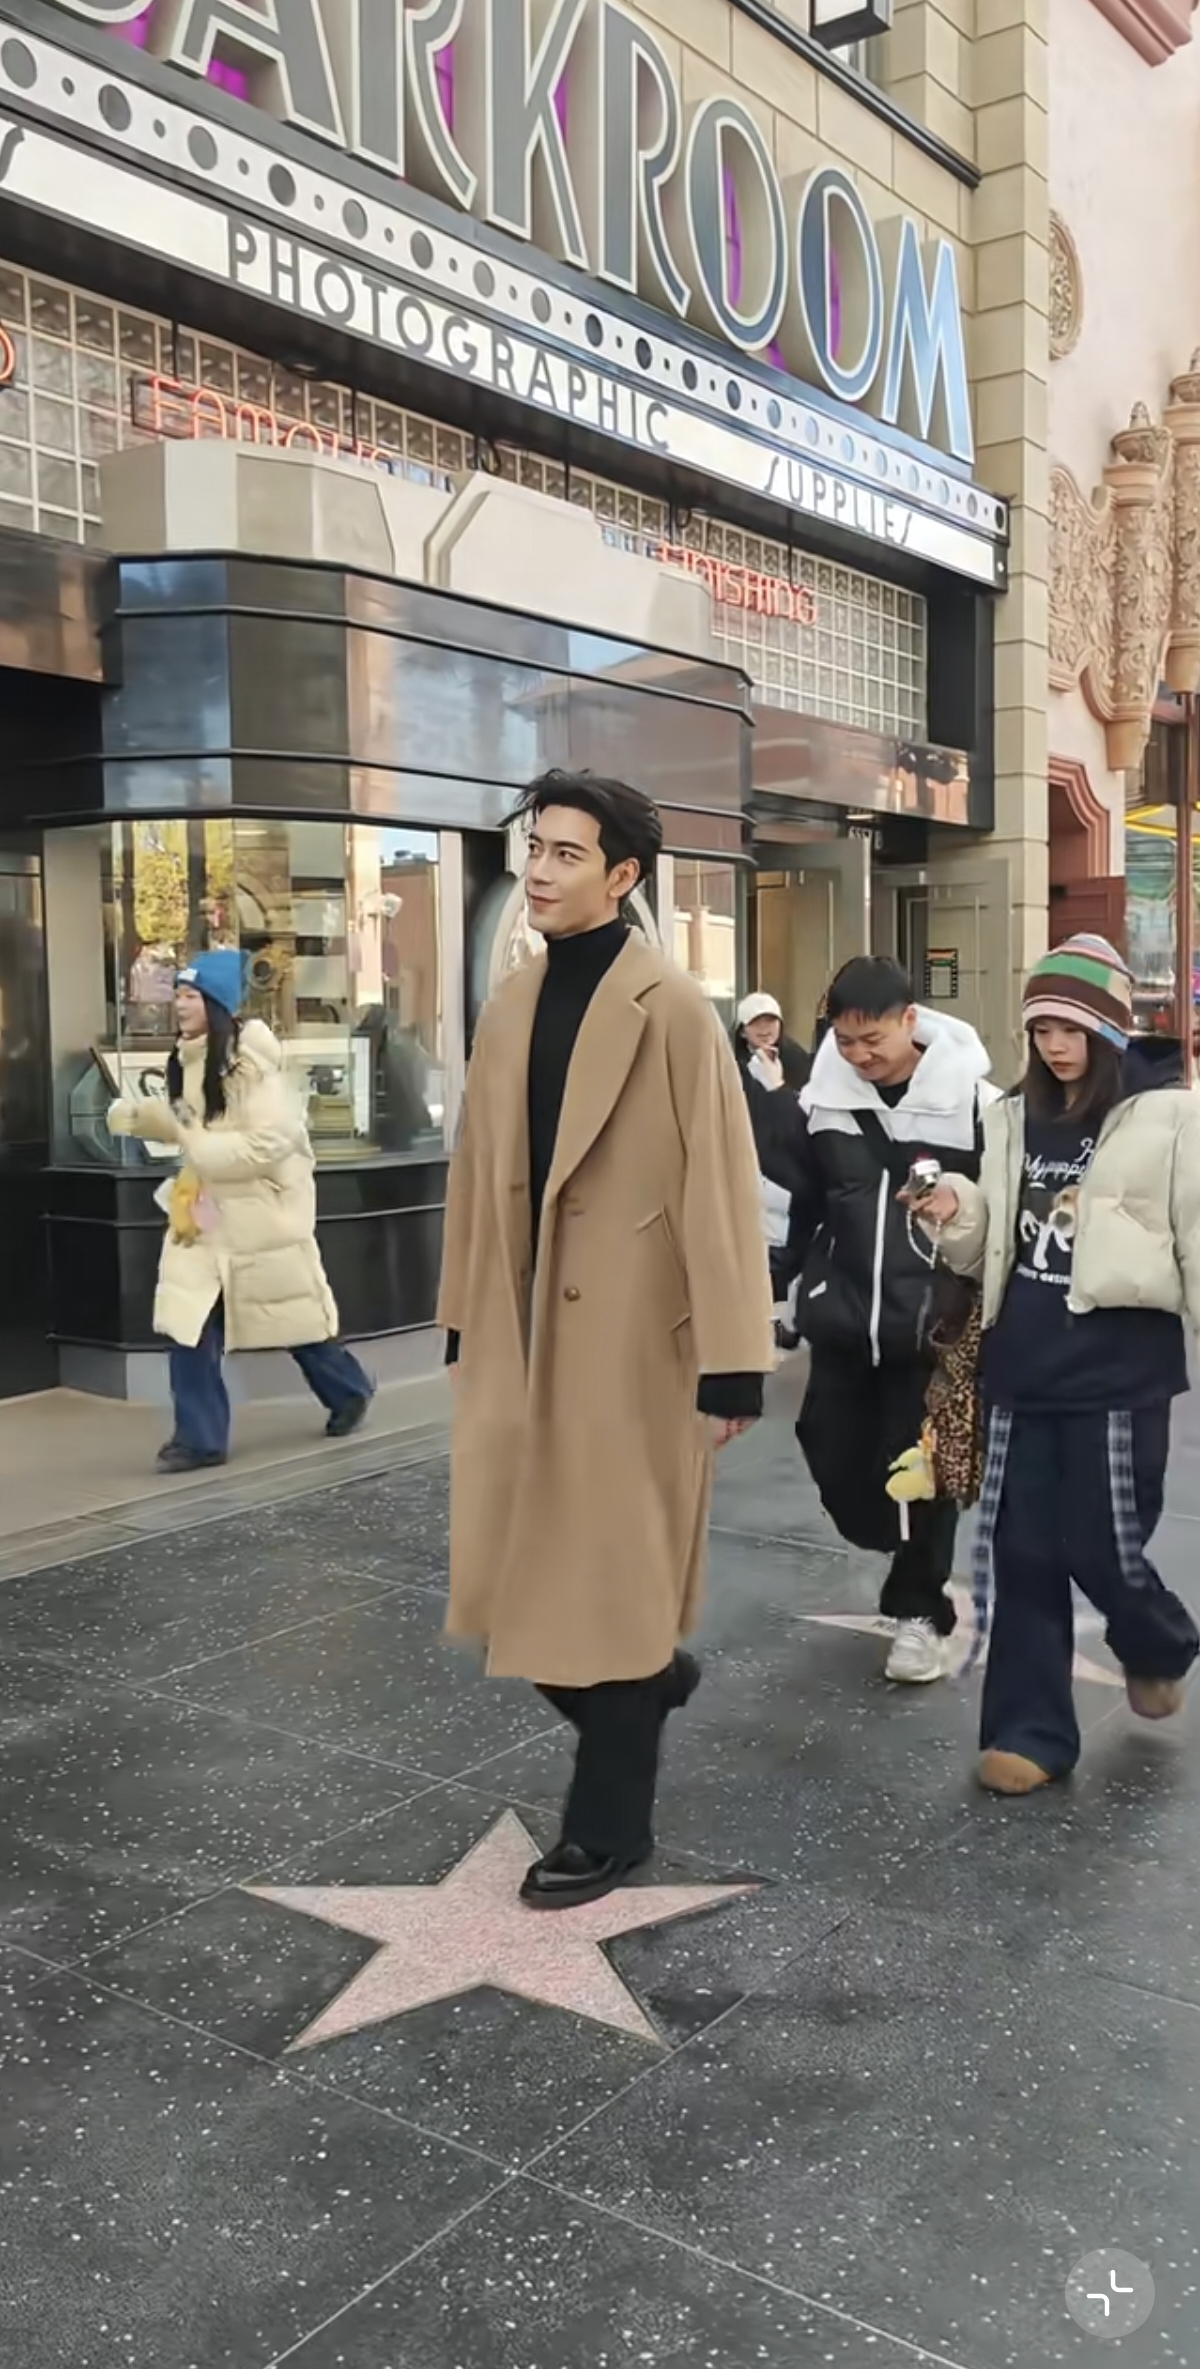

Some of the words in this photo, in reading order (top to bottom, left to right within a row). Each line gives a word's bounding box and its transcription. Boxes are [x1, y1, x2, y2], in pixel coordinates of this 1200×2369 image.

[58, 0, 975, 463] RKROOM
[229, 220, 670, 451] PHOTOGRAPHIC
[763, 455, 913, 546] SUPPLIES
